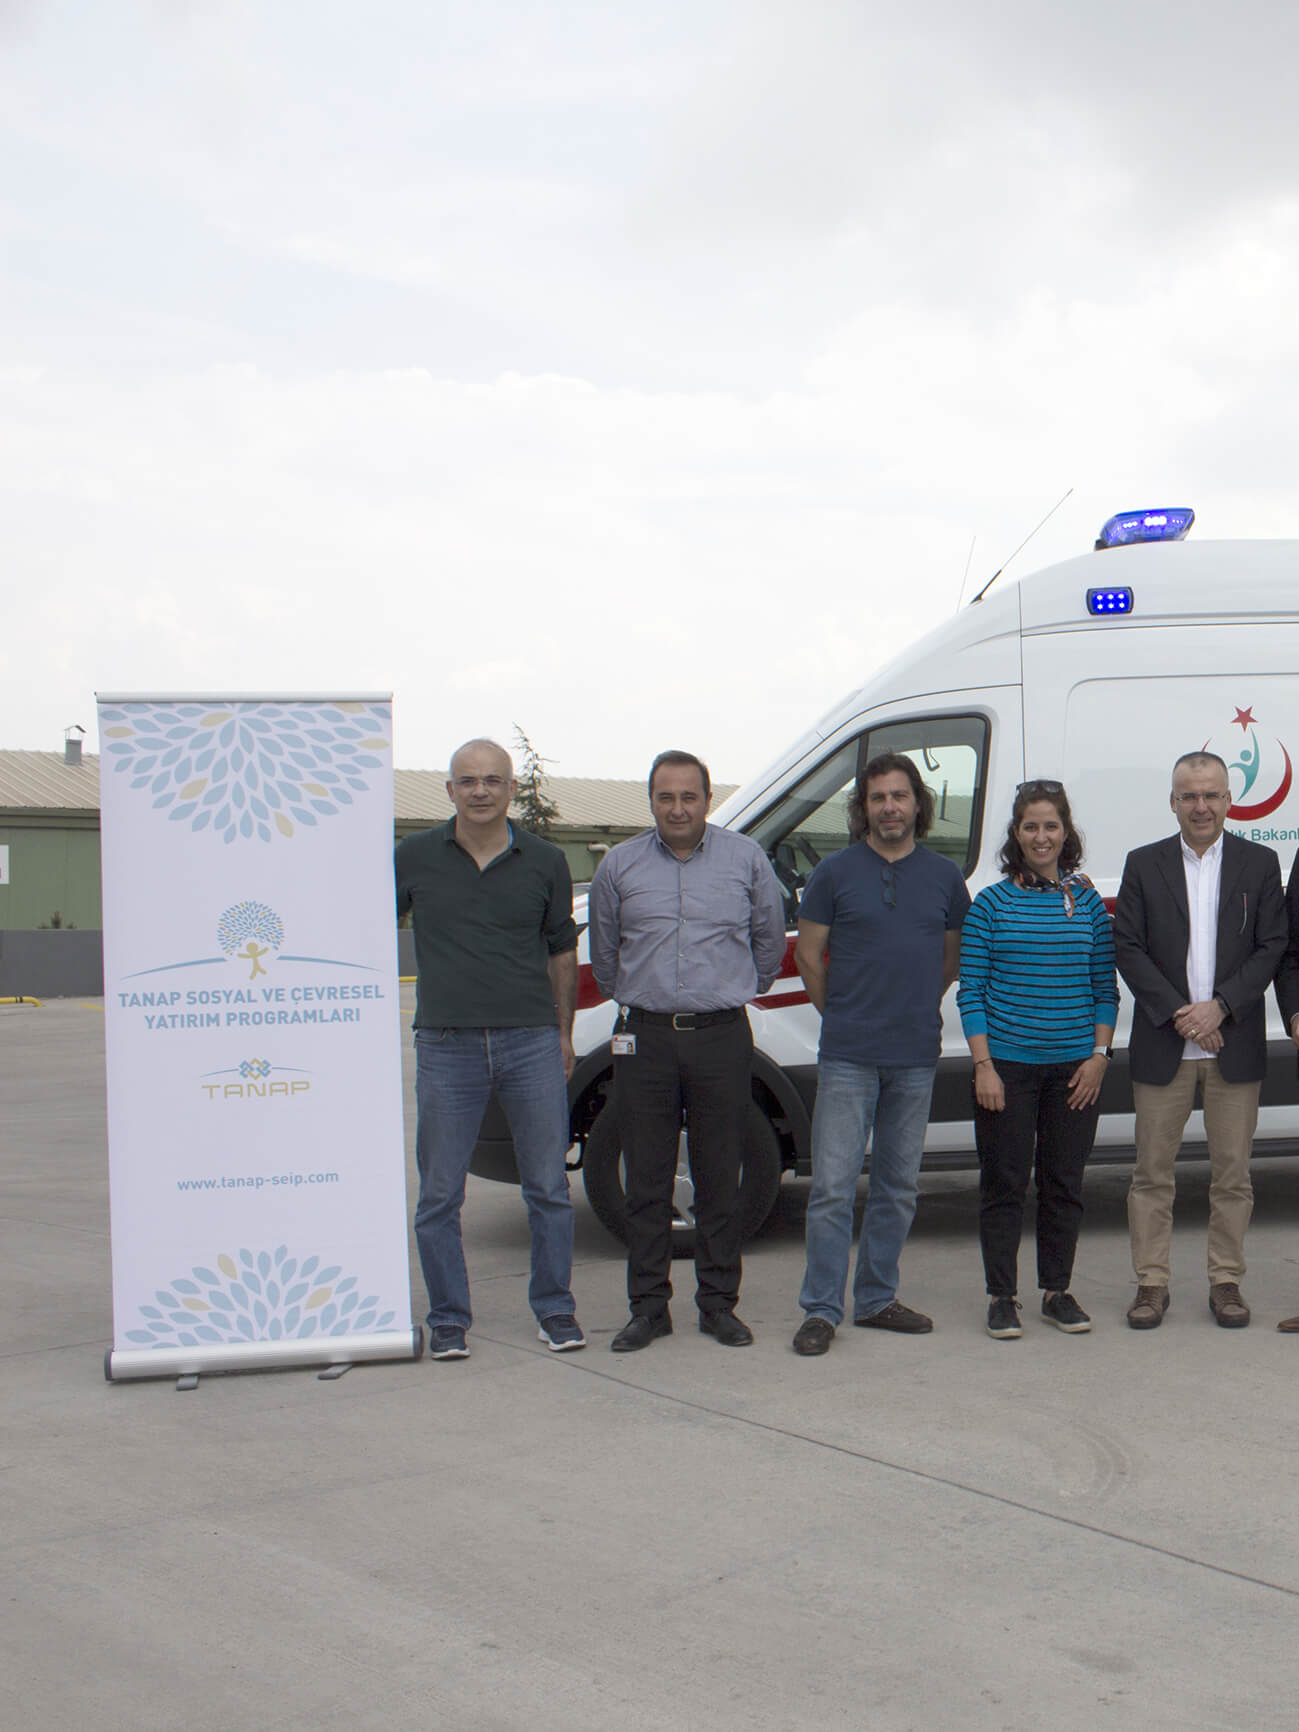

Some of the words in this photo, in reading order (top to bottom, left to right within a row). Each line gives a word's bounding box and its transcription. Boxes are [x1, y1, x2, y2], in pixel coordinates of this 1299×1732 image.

[118, 991, 181, 1008] TANAP
[186, 989, 256, 1005] SOSYAL
[262, 988, 285, 1002] VE
[291, 985, 385, 1005] ÇEVRESEL
[144, 1012, 220, 1029] YATIRIM
[226, 1008, 361, 1027] PROGRAMLARI
[202, 1082, 310, 1099] TANAP
[177, 1172, 339, 1191] www.tanap-seip.com
